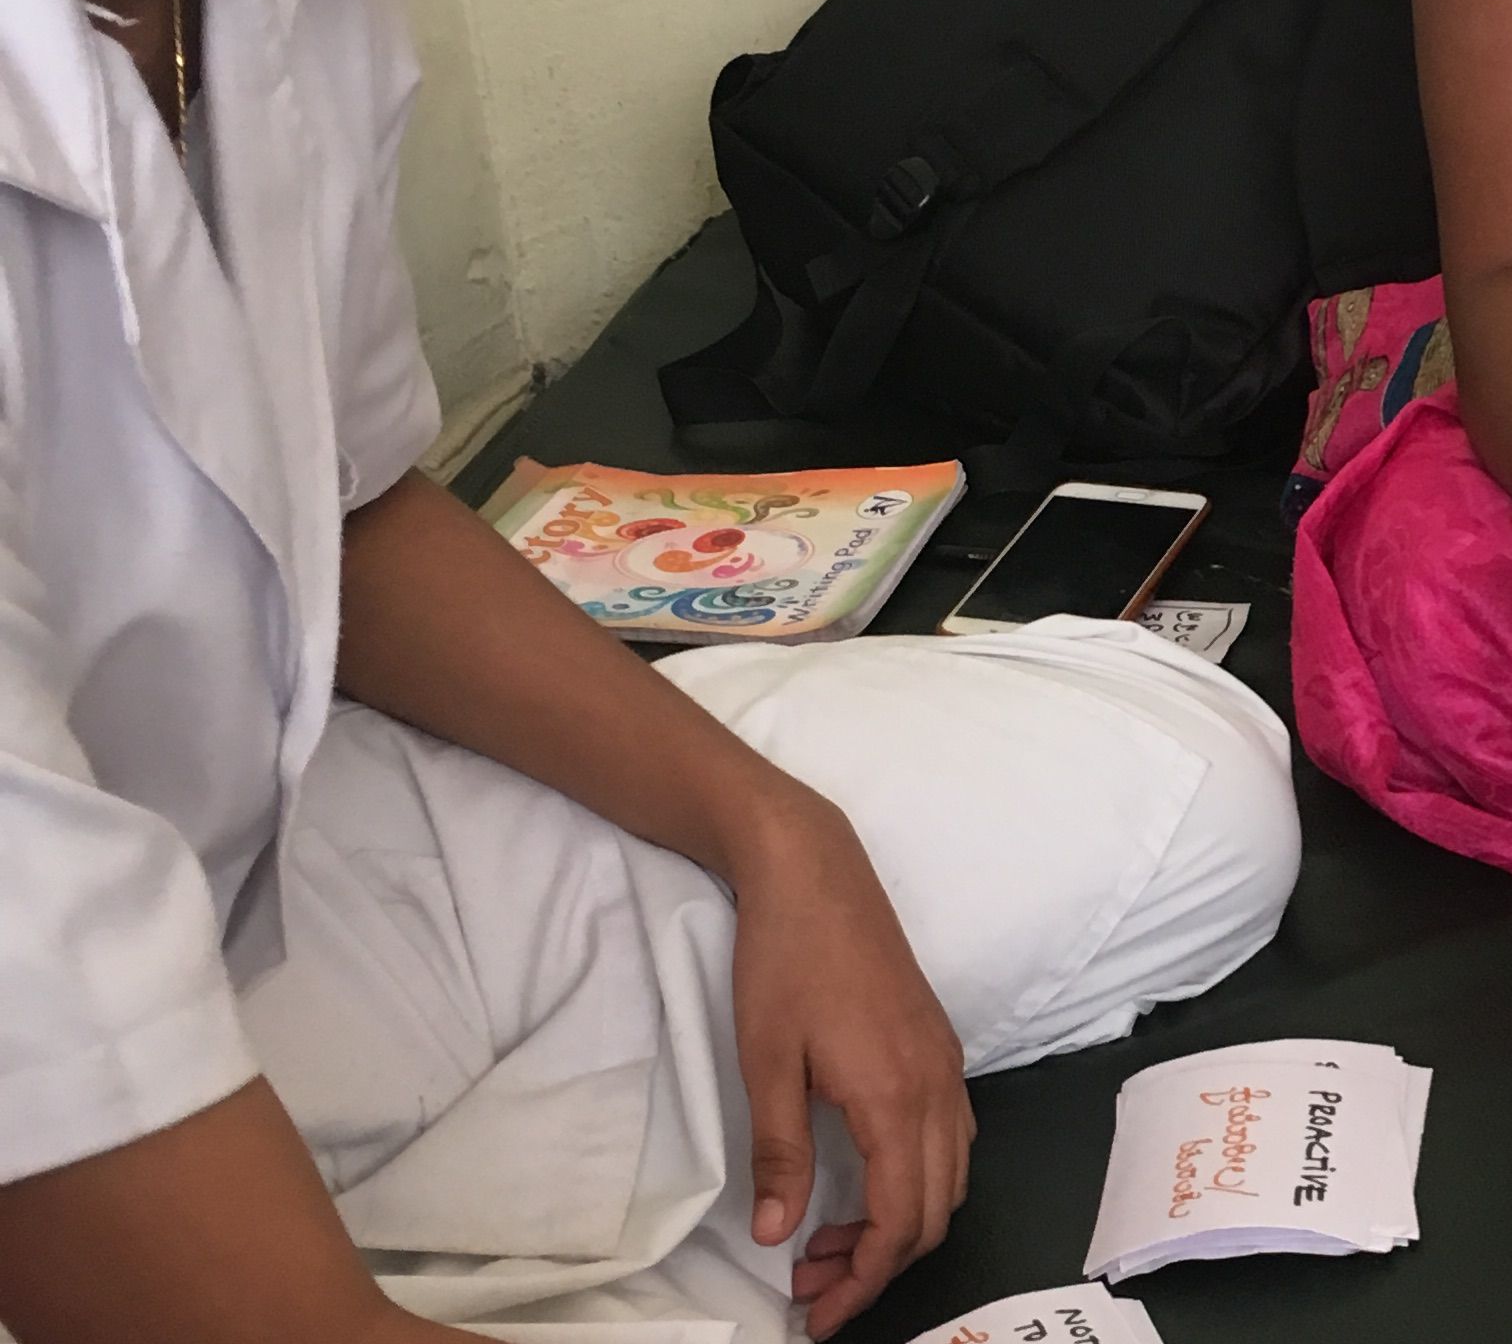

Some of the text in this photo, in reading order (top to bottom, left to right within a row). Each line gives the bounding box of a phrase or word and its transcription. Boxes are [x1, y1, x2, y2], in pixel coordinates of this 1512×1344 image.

[519, 486, 613, 565] ctory
[782, 528, 874, 626] Writing Pad
[1013, 1318, 1048, 1342] TO
